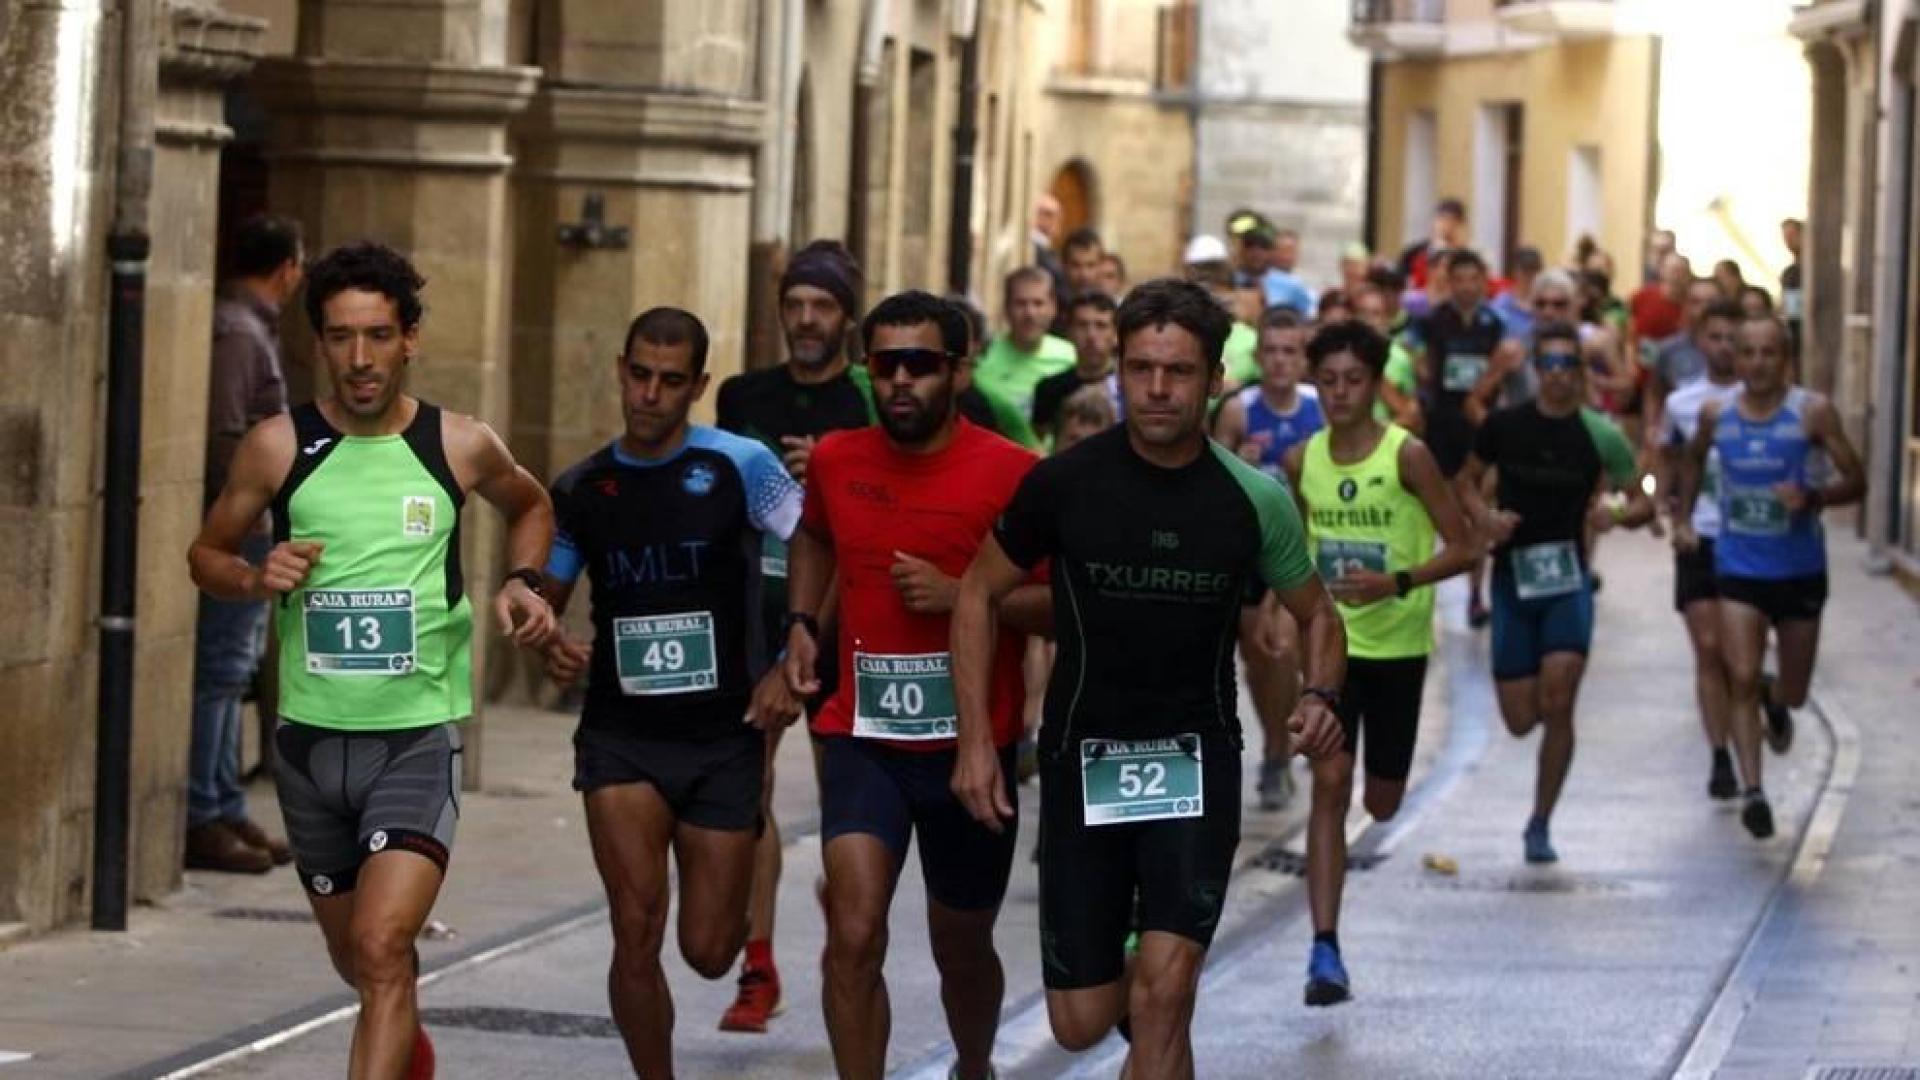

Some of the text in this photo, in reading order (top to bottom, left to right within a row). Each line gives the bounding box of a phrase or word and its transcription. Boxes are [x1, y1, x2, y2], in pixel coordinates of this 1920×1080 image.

[335, 615, 382, 651] 13
[642, 640, 684, 672] 49
[879, 681, 924, 716] 40
[1118, 761, 1168, 798] 52
